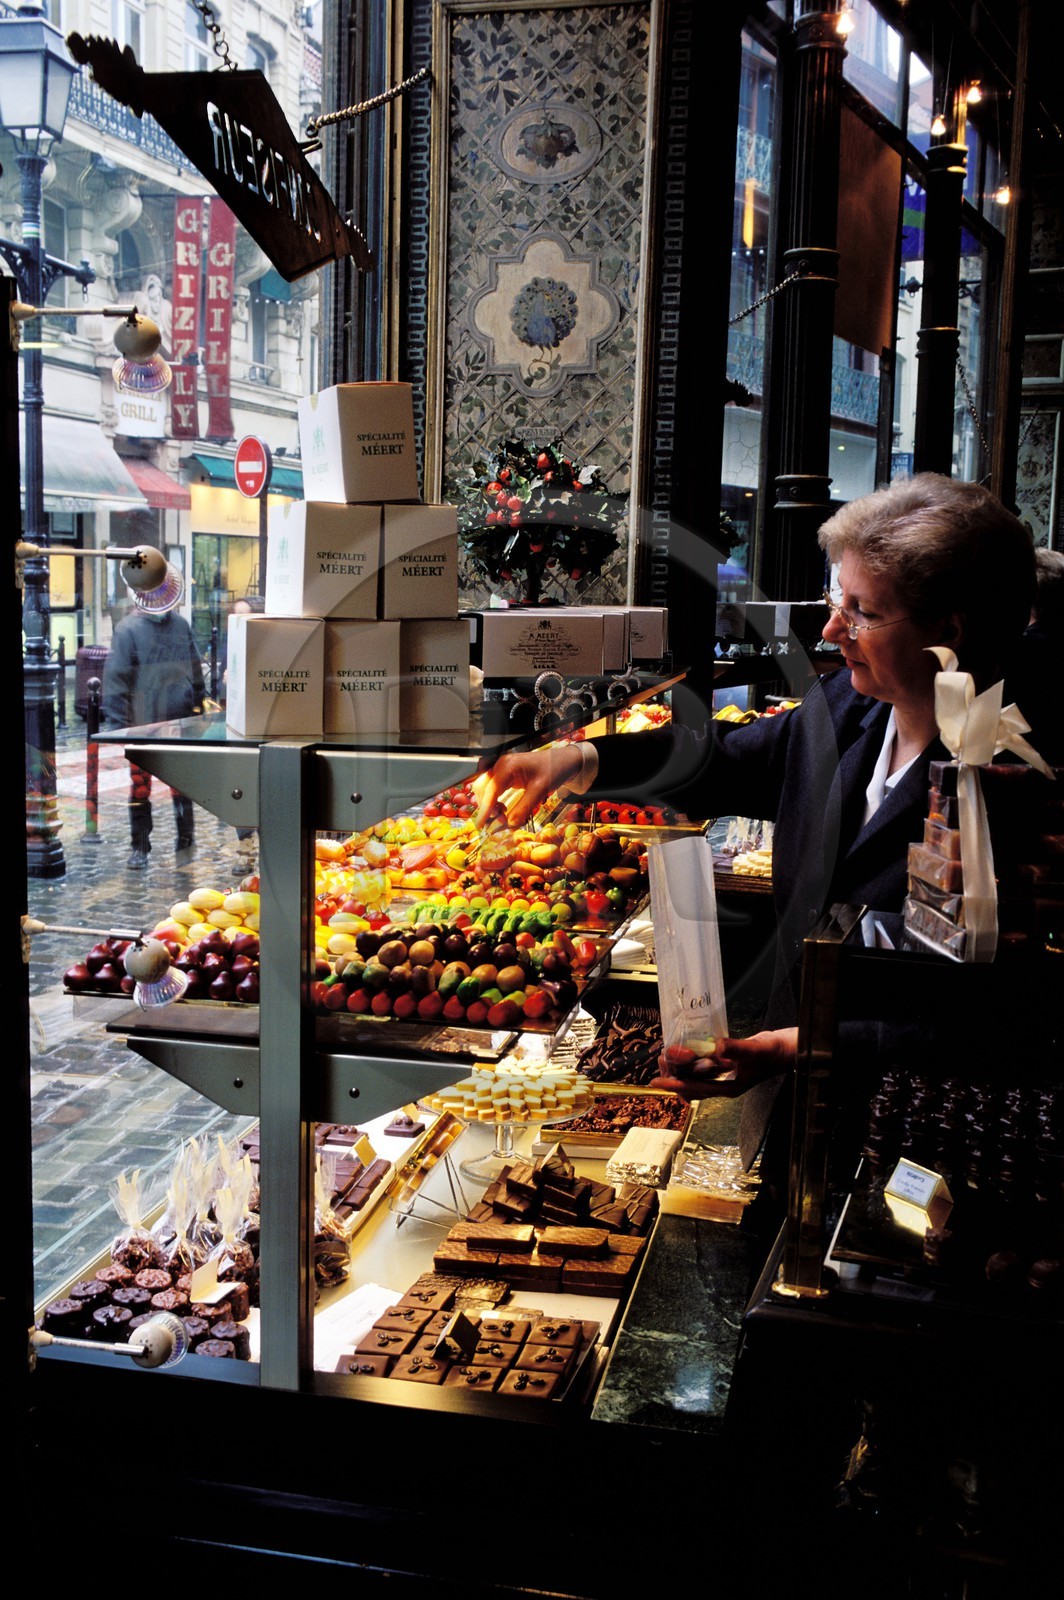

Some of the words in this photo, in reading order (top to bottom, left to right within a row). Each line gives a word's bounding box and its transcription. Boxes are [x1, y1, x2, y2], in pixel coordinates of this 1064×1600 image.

[175, 208, 200, 428] GRIZZLY
[207, 242, 235, 398] GRILL
[121, 402, 157, 422] GRILL
[356, 430, 406, 441] SPÉCIALITÉ
[361, 443, 404, 456] MÉERT
[316, 550, 367, 562] SPÉCIALITÉ
[398, 552, 447, 562] SPÉCIALITÉ
[319, 561, 364, 576] MÉERT
[402, 564, 445, 577] MÉERT
[258, 668, 311, 678] SPÉCIALITÉ
[336, 668, 387, 678] SPÉCIALITÉ
[409, 663, 459, 673] SPÉCIALITÉ
[261, 678, 307, 692] MÉERT
[340, 678, 384, 692] MÉERT
[412, 673, 456, 686] MÉERT
